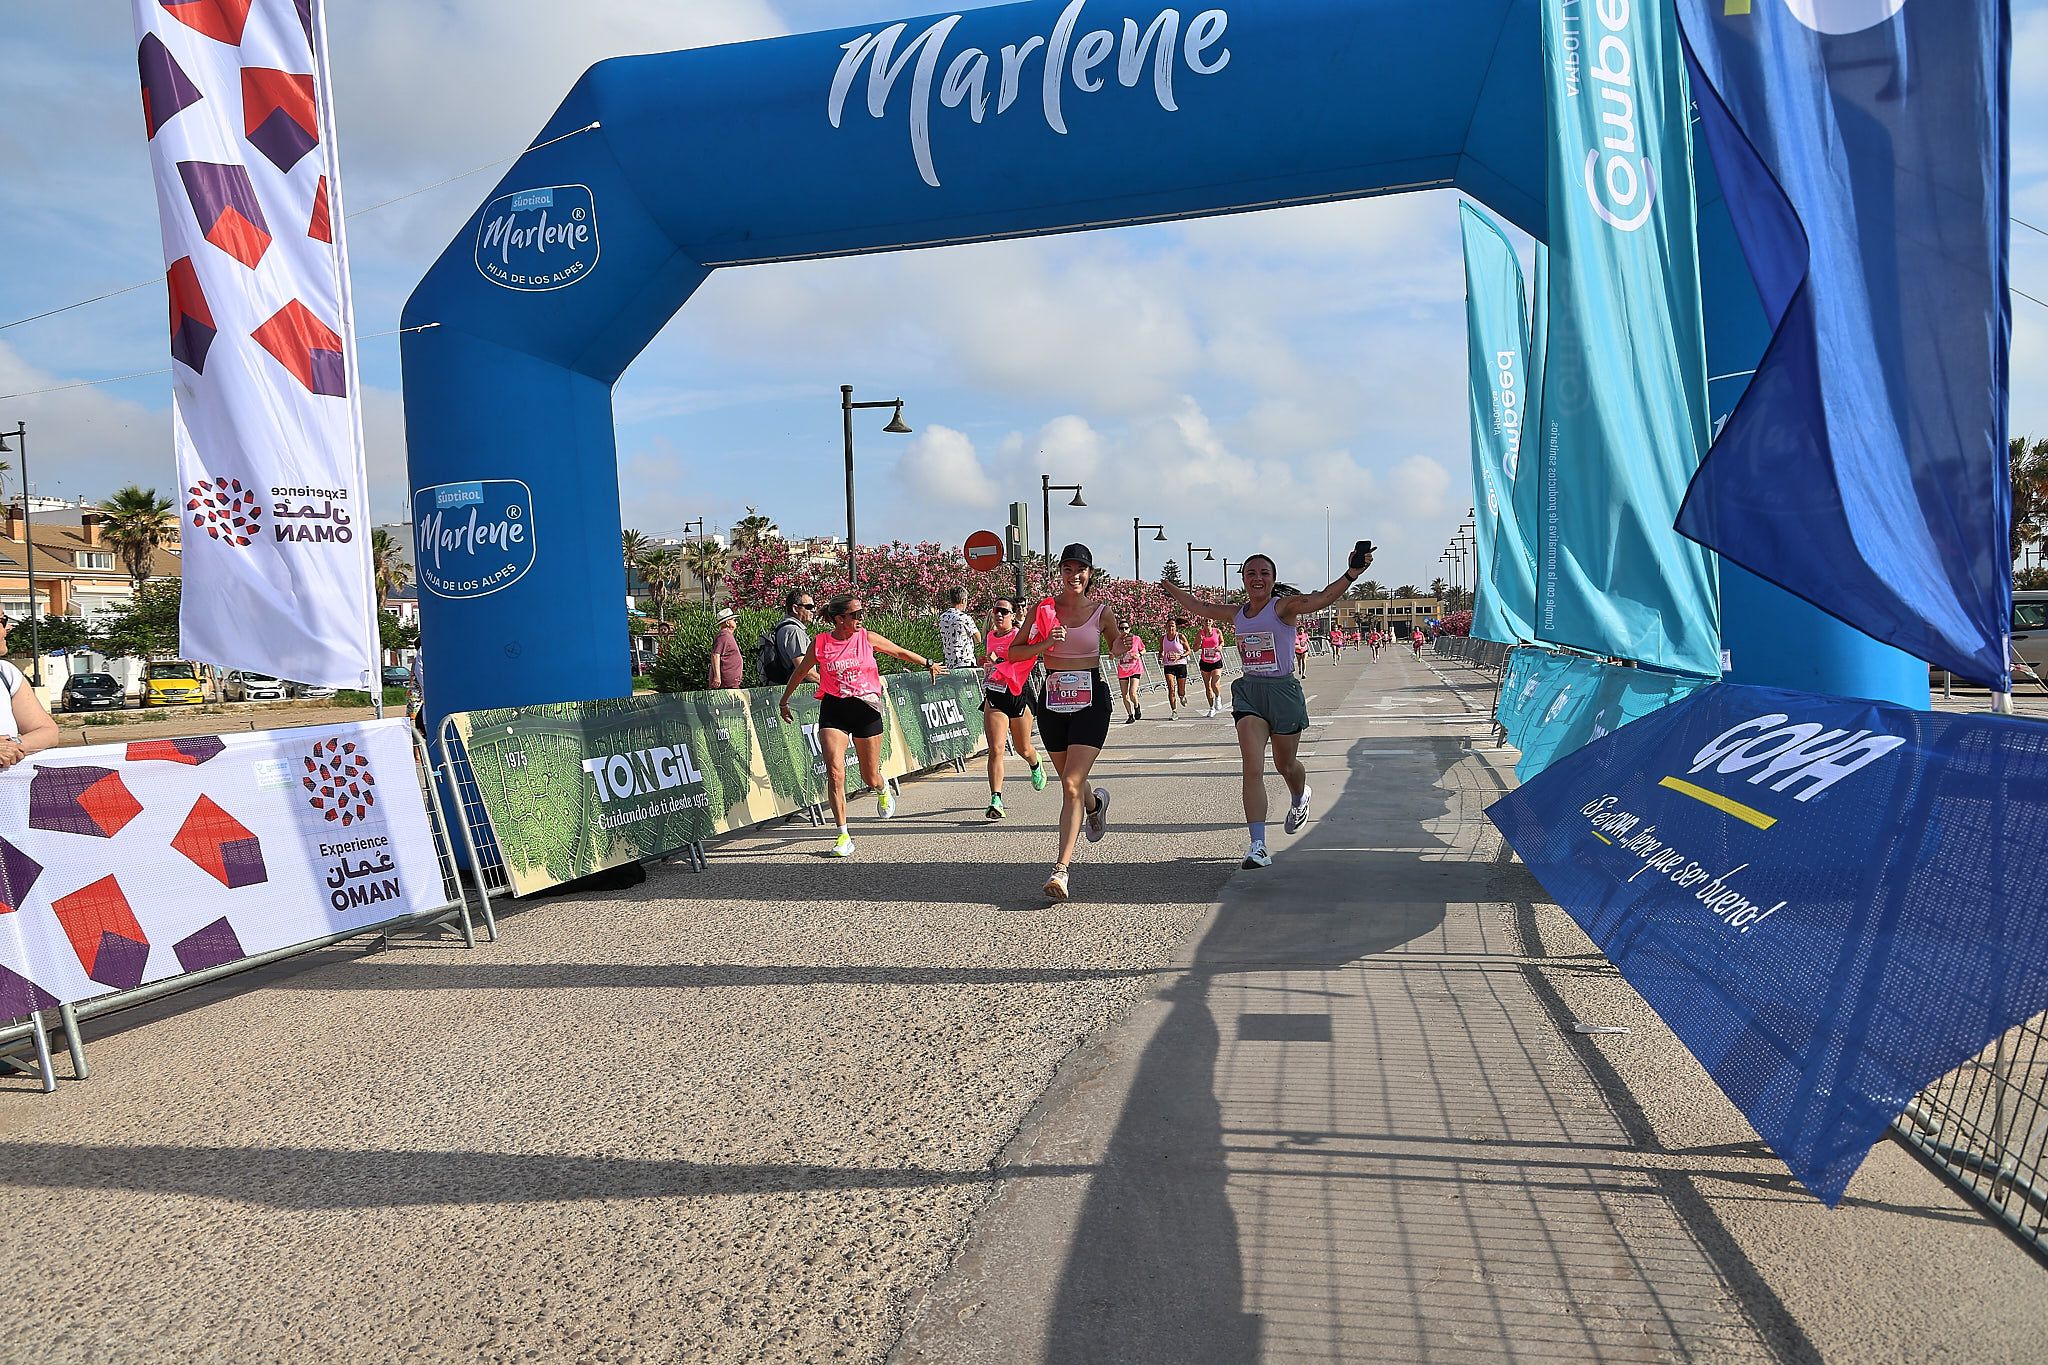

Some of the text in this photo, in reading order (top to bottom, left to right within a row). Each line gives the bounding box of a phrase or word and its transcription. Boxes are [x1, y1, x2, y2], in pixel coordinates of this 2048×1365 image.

[828, 0, 1230, 186] Marlene
[483, 209, 588, 264] Marlene
[487, 261, 584, 285] HIJA DE LOS ALPES
[420, 507, 525, 570] Marlene
[425, 562, 517, 590] HIJA DE LOS ALPES
[504, 751, 528, 768] 1975
[1687, 713, 1907, 802] GOYA
[598, 792, 709, 831] Cuidando de ti desde 1975
[319, 834, 389, 857] Experience
[330, 877, 401, 911] OMAN
[1627, 847, 1685, 883] que
[1670, 862, 1710, 889] ser
[1695, 863, 1787, 933] bueno!
